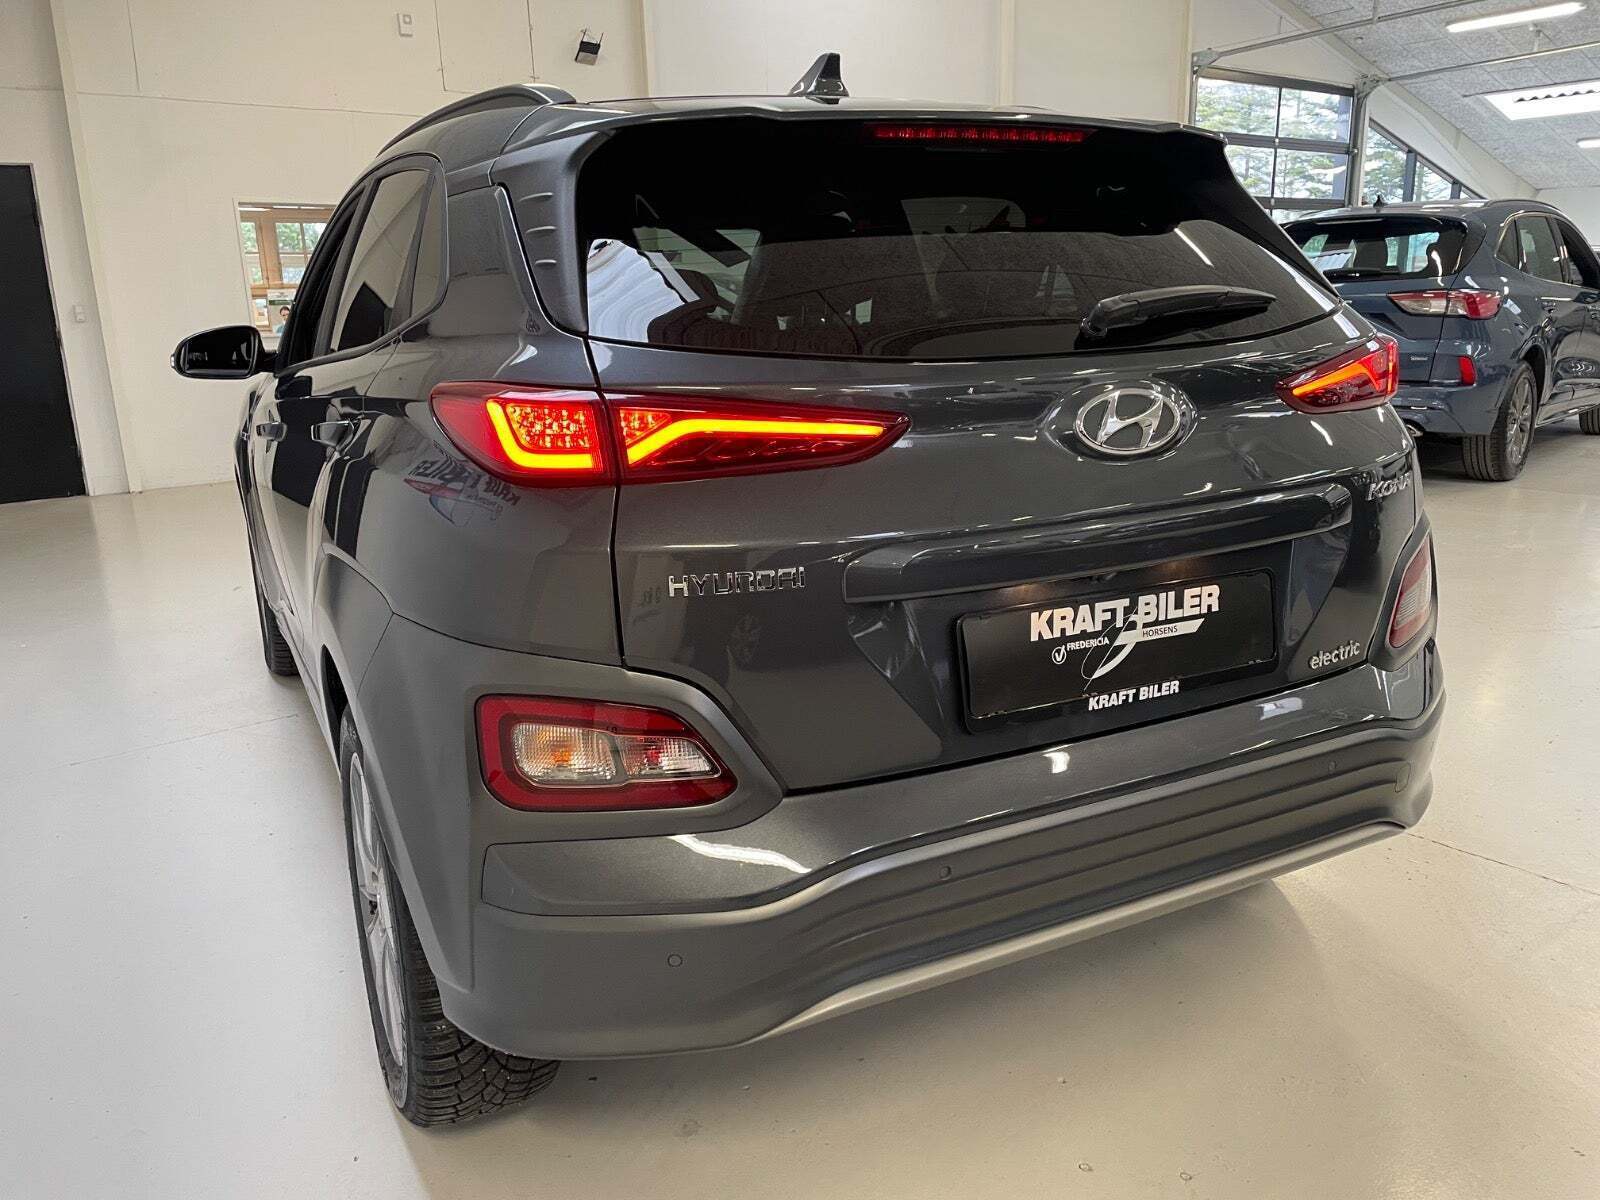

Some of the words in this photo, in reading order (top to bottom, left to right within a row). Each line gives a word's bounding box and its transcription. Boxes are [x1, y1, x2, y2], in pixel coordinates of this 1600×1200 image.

[668, 566, 805, 597] HYUNDAI
[1030, 599, 1129, 641] KRAFT
[1138, 585, 1220, 623] BILER
[1066, 637, 1110, 651] FREDERICIA
[1142, 625, 1178, 638] HORSENS
[1310, 641, 1360, 670] electric
[1088, 690, 1136, 711] KRAFT
[1139, 681, 1179, 699] BILER
